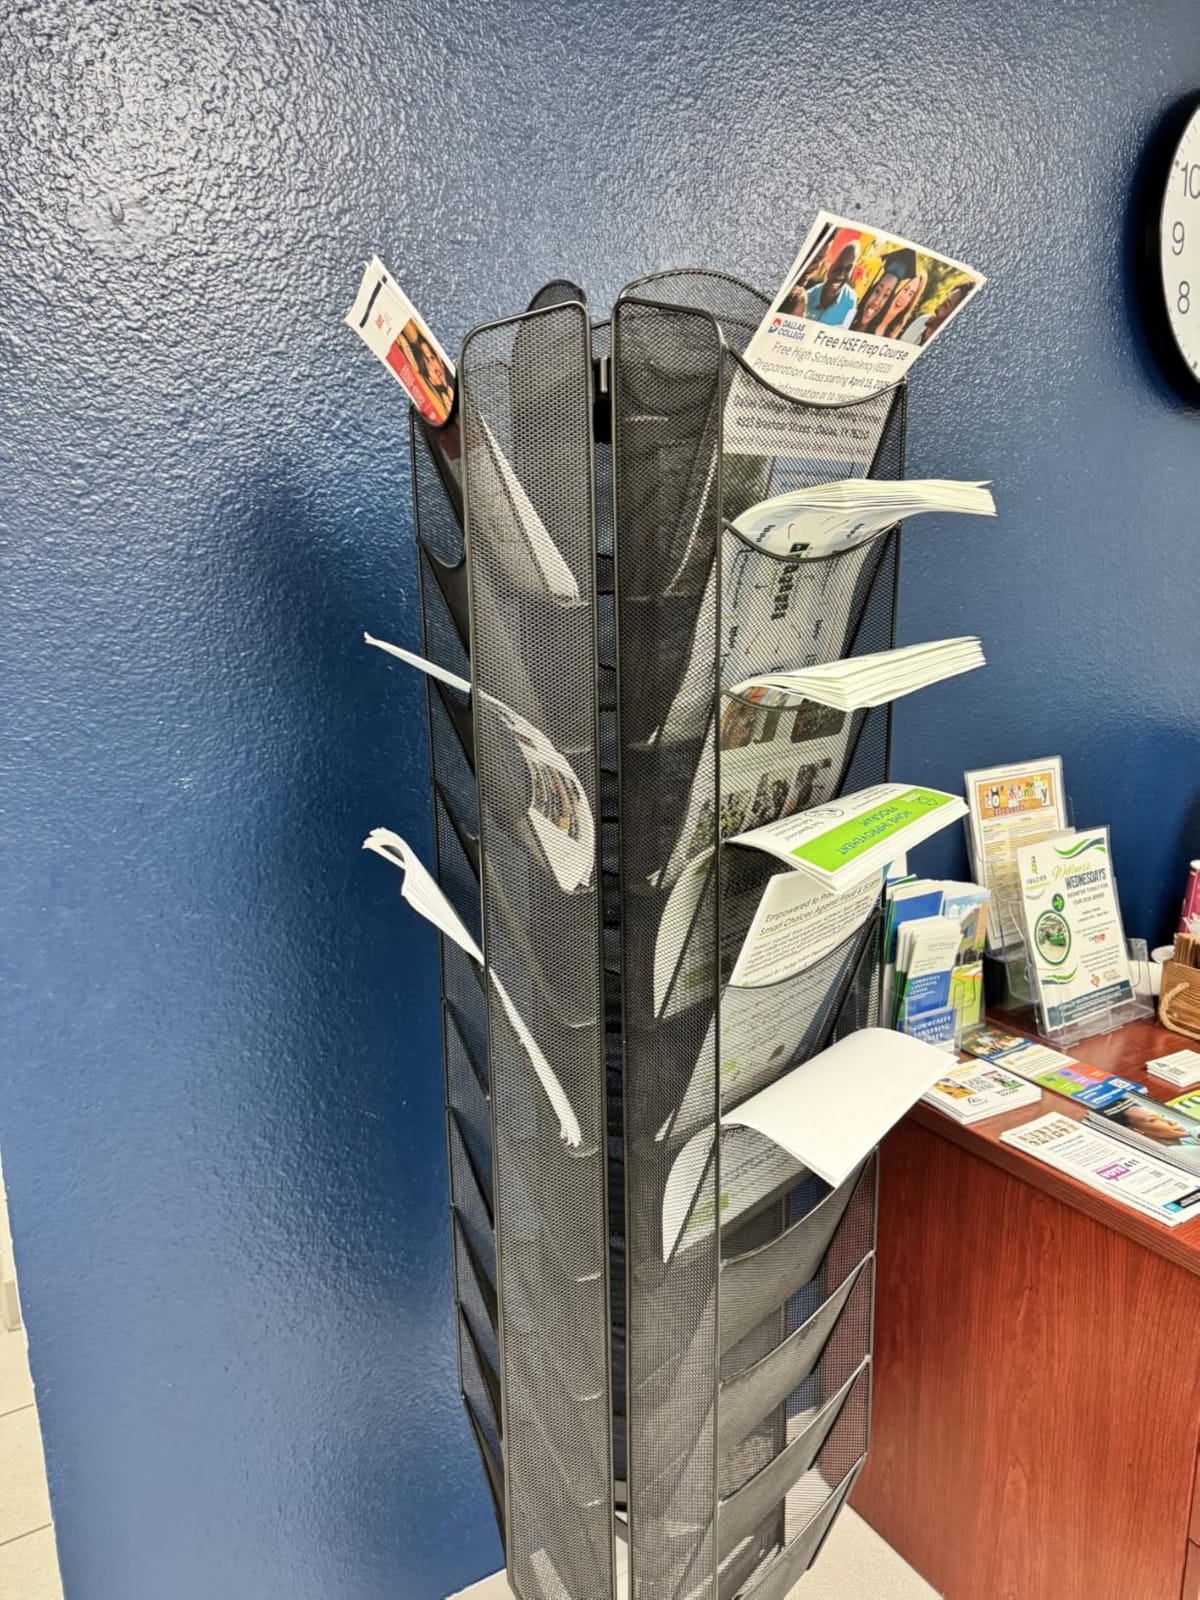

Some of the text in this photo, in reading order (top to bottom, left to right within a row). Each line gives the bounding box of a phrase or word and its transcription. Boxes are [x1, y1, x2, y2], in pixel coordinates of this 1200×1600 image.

[1172, 221, 1185, 256] 9
[1177, 281, 1190, 314] 8
[777, 328, 806, 341] COLLEGE
[782, 319, 806, 332] DALLAS
[772, 342, 793, 355] Free
[791, 346, 811, 361] High
[811, 351, 840, 366] School
[813, 330, 910, 361] Free HSE Prep Course
[753, 358, 803, 378] Preparation
[804, 369, 825, 382] Class
[825, 374, 849, 387] starting
[848, 376, 867, 389] April
[1064, 868, 1107, 890] WEDNESDAYS
[1125, 1158, 1140, 1169] 411
